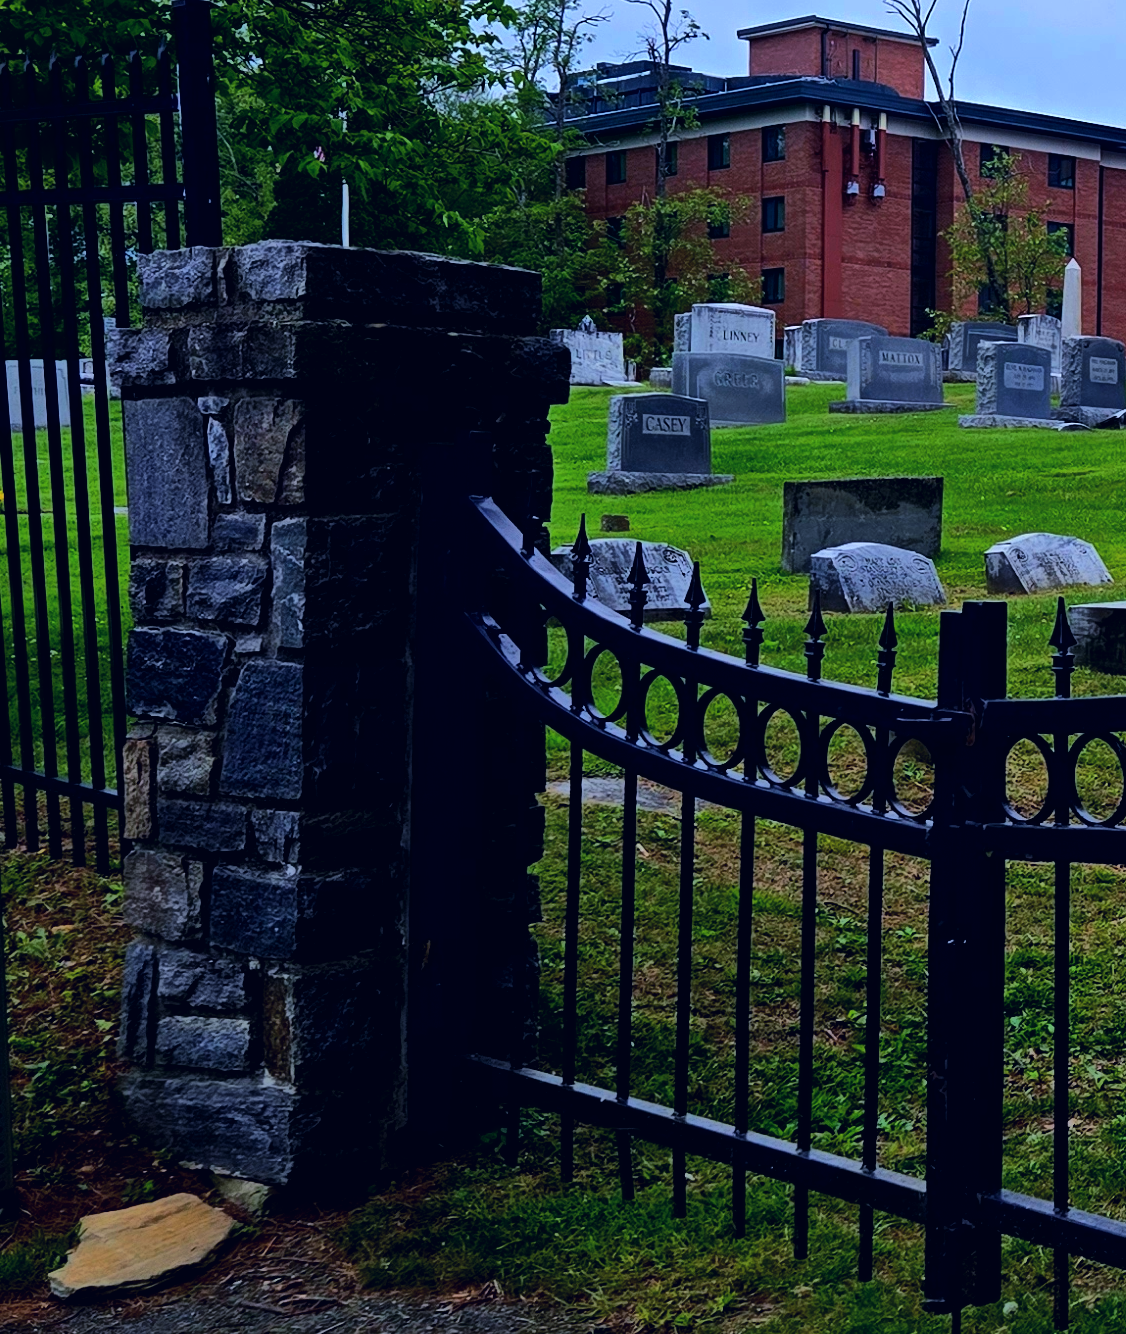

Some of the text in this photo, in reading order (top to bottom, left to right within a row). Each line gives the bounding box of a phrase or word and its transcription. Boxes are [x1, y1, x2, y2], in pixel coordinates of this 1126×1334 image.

[723, 329, 760, 343] LINNEY
[882, 352, 920, 364] MATTOX
[645, 416, 687, 432] CASEY
